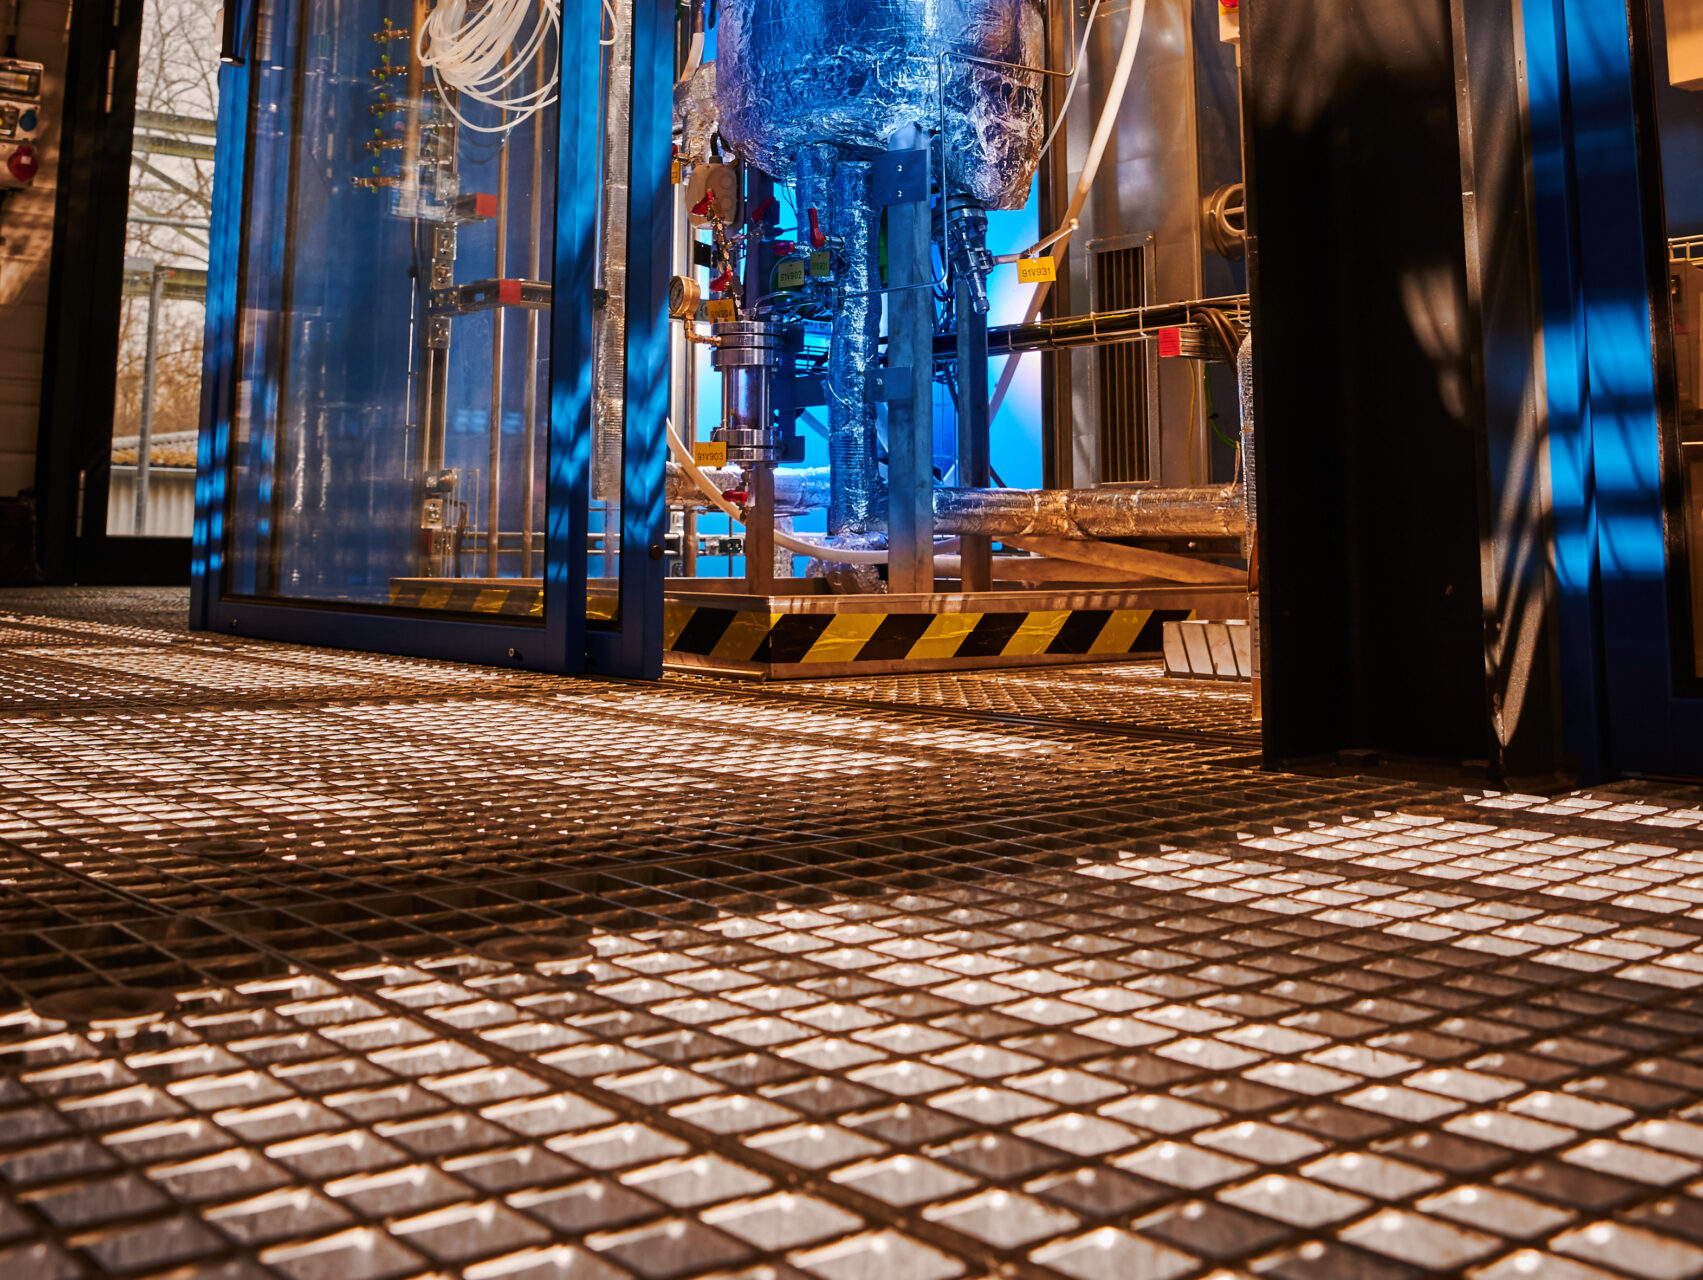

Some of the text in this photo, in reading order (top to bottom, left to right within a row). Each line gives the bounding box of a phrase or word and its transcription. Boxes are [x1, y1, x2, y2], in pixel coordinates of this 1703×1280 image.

[780, 270, 802, 282] 91V902
[1022, 267, 1051, 278] 91V931
[710, 308, 733, 319] 91V904
[697, 451, 724, 461] 91V903
